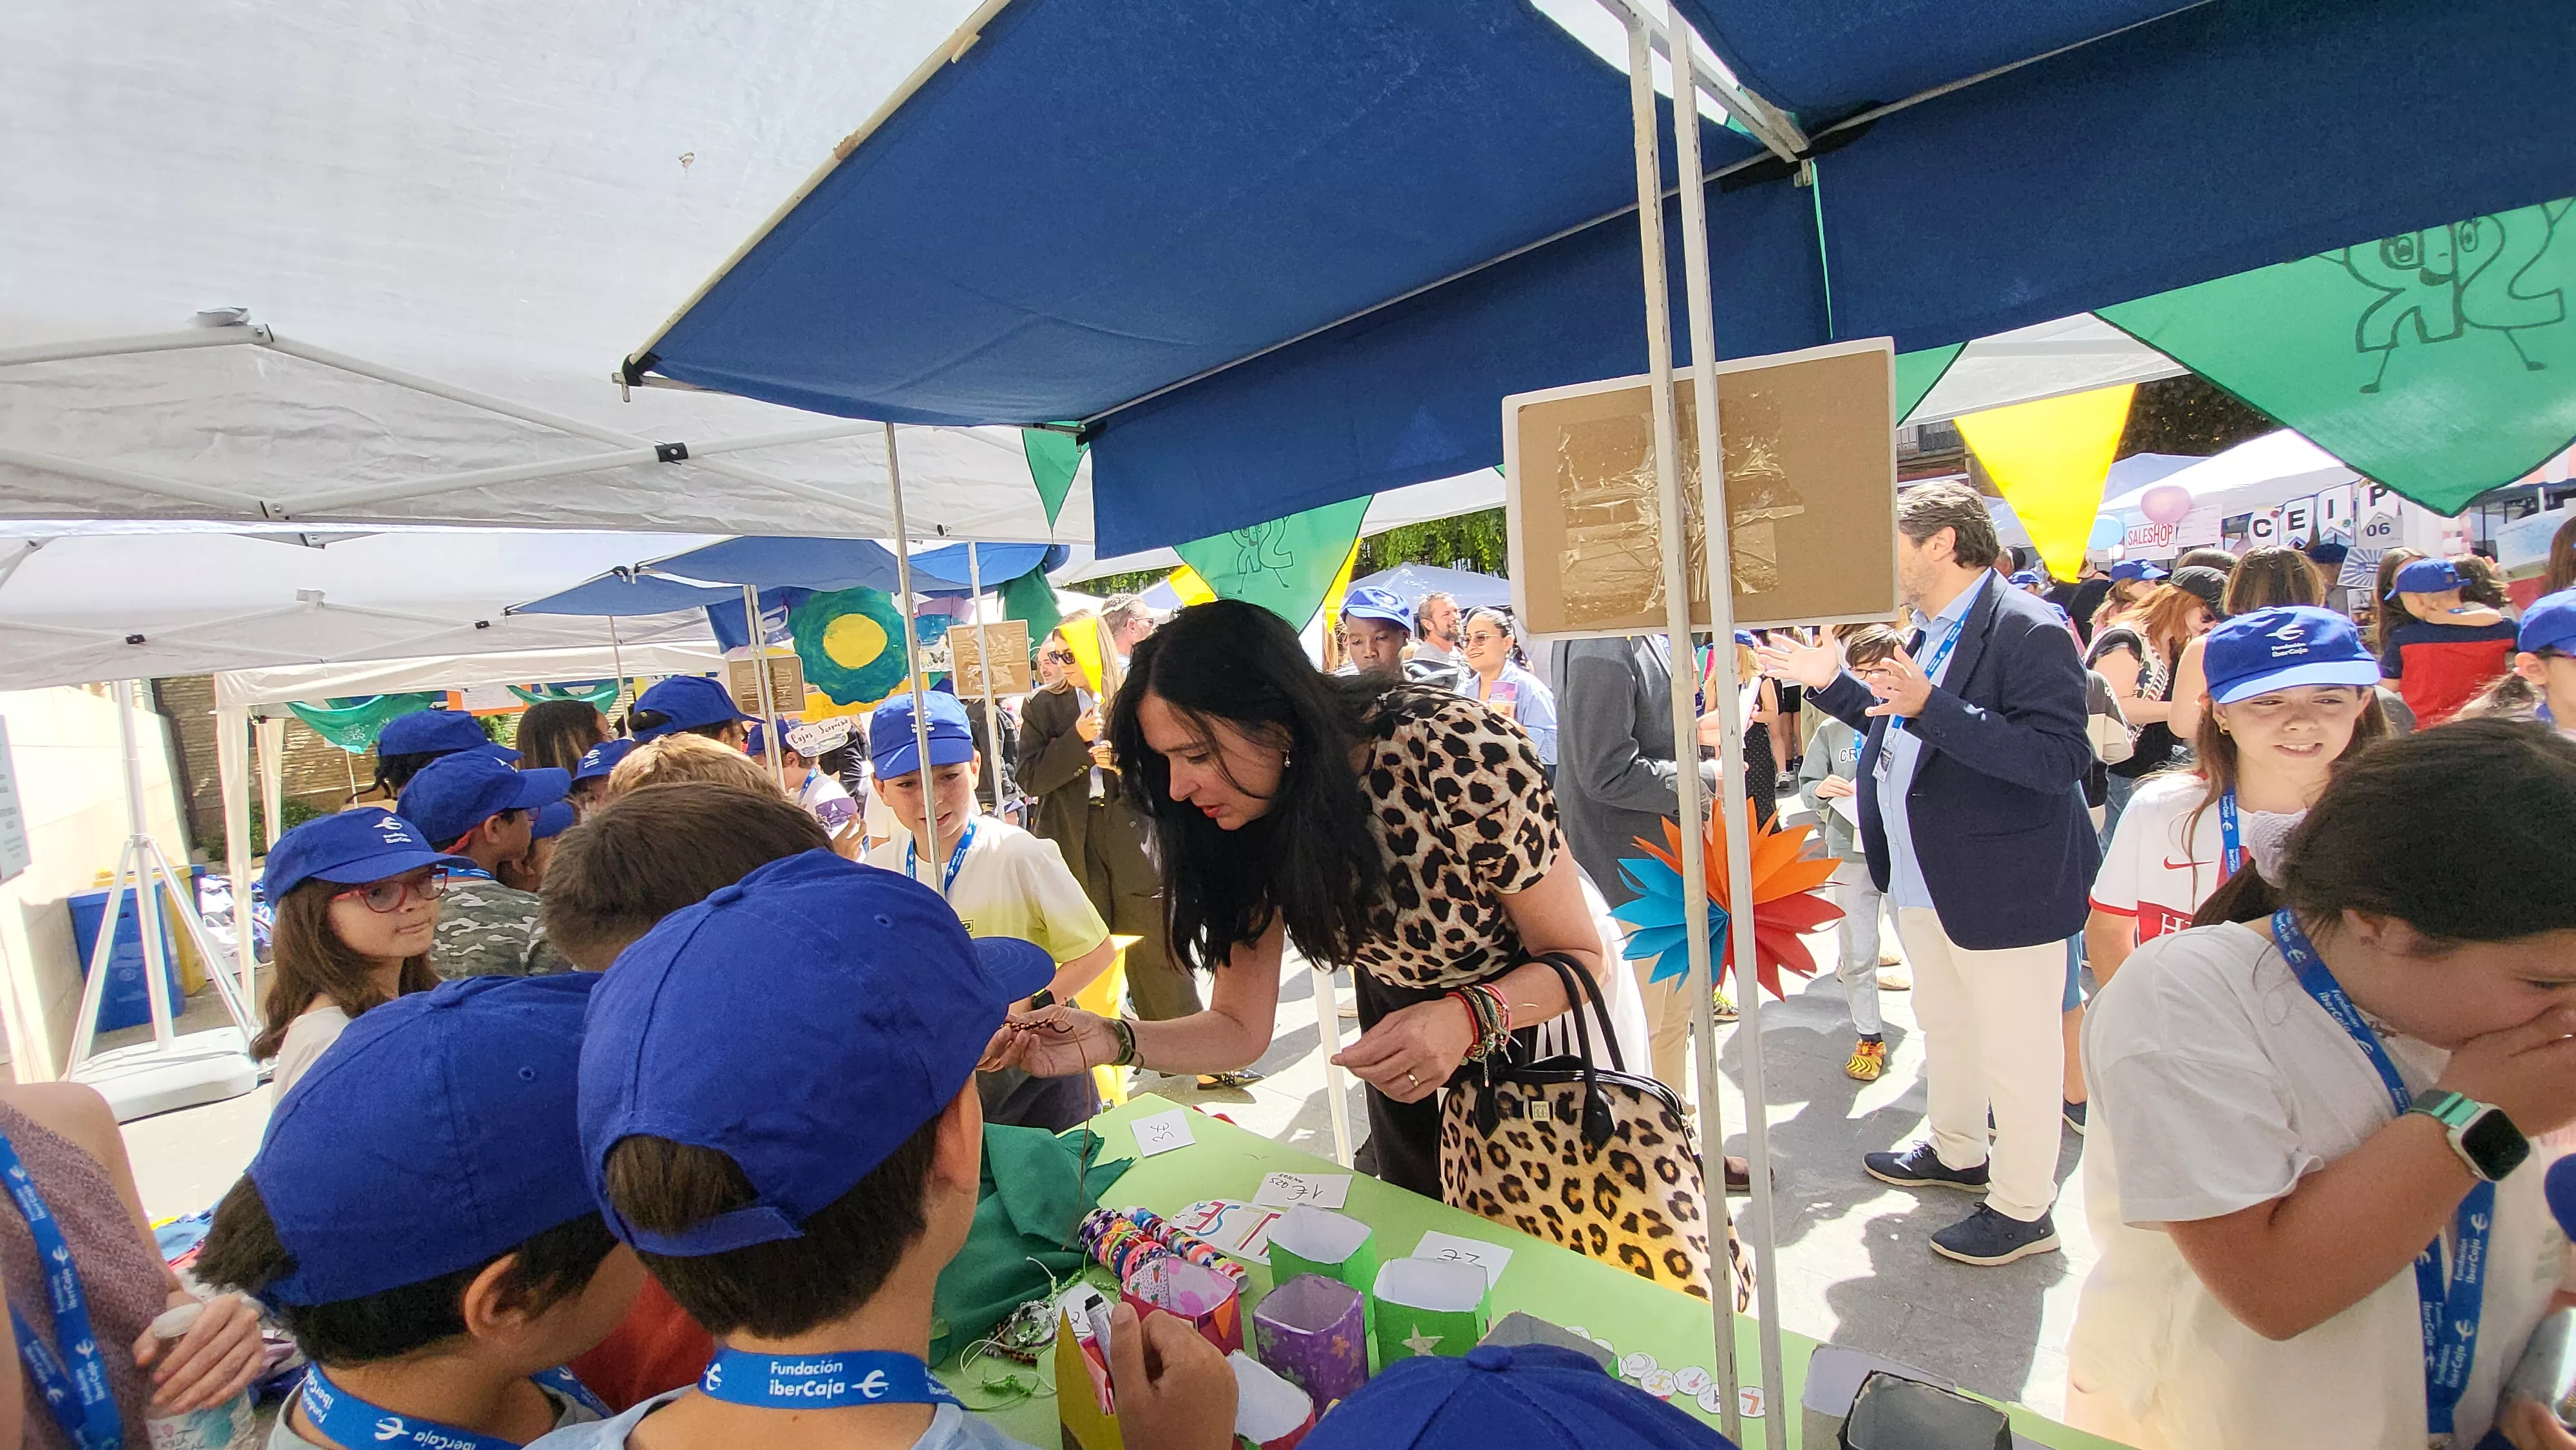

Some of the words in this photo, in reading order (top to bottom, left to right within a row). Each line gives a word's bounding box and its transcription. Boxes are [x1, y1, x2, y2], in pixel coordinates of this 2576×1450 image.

[2367, 522, 2391, 537] 06
[791, 733, 813, 744] Cajas
[1839, 747, 1858, 763] CR
[770, 1360, 843, 1375] Fundación
[769, 1379, 845, 1399] iberCaja
